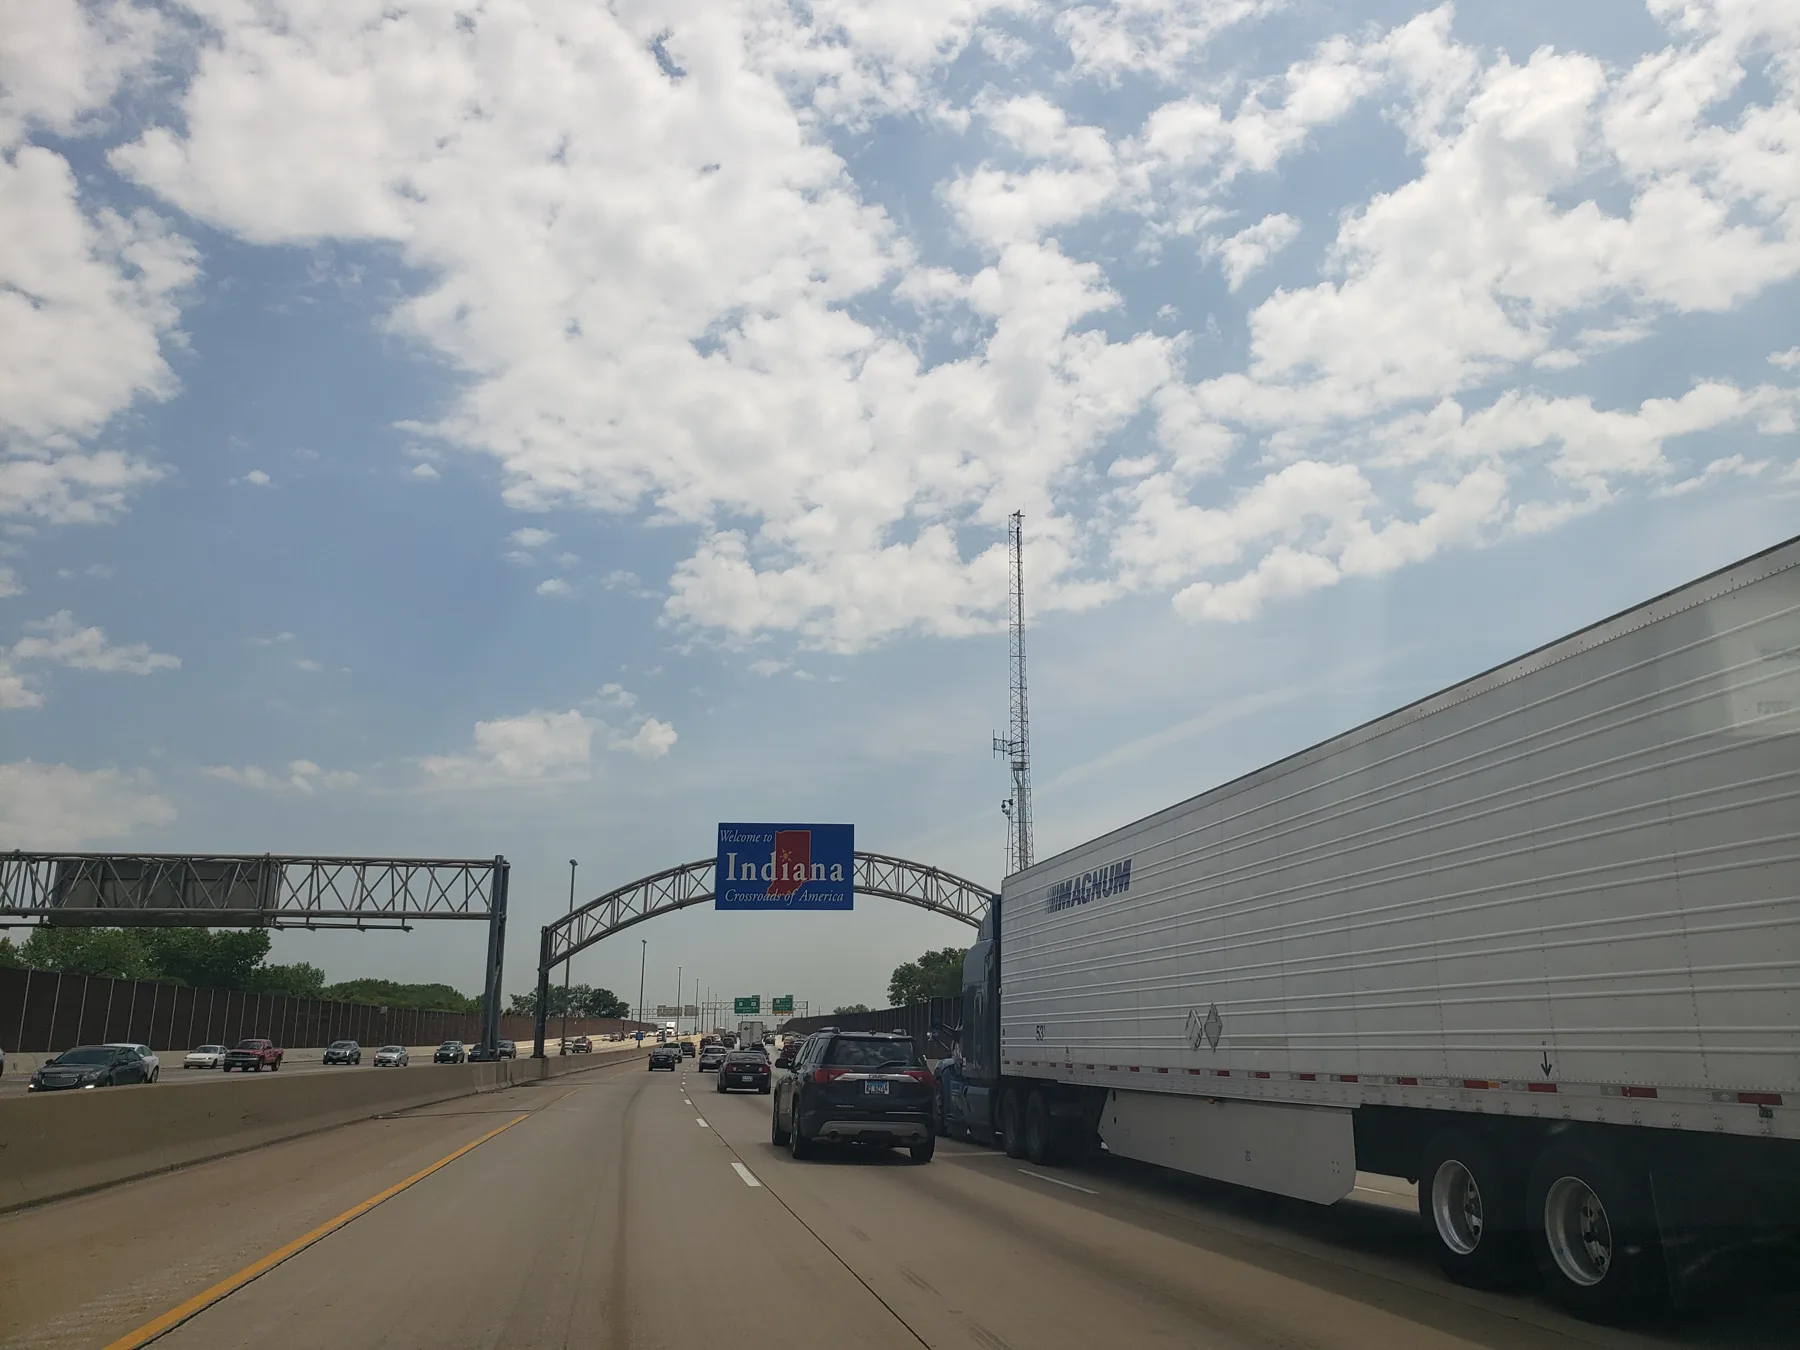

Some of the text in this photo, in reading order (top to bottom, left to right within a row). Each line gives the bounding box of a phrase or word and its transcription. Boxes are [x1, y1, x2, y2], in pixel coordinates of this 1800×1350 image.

[720, 829, 773, 842] Welcome to
[725, 850, 845, 882] Indiana
[1053, 859, 1132, 910] MAGNUM
[725, 889, 844, 905] Crossroads of America
